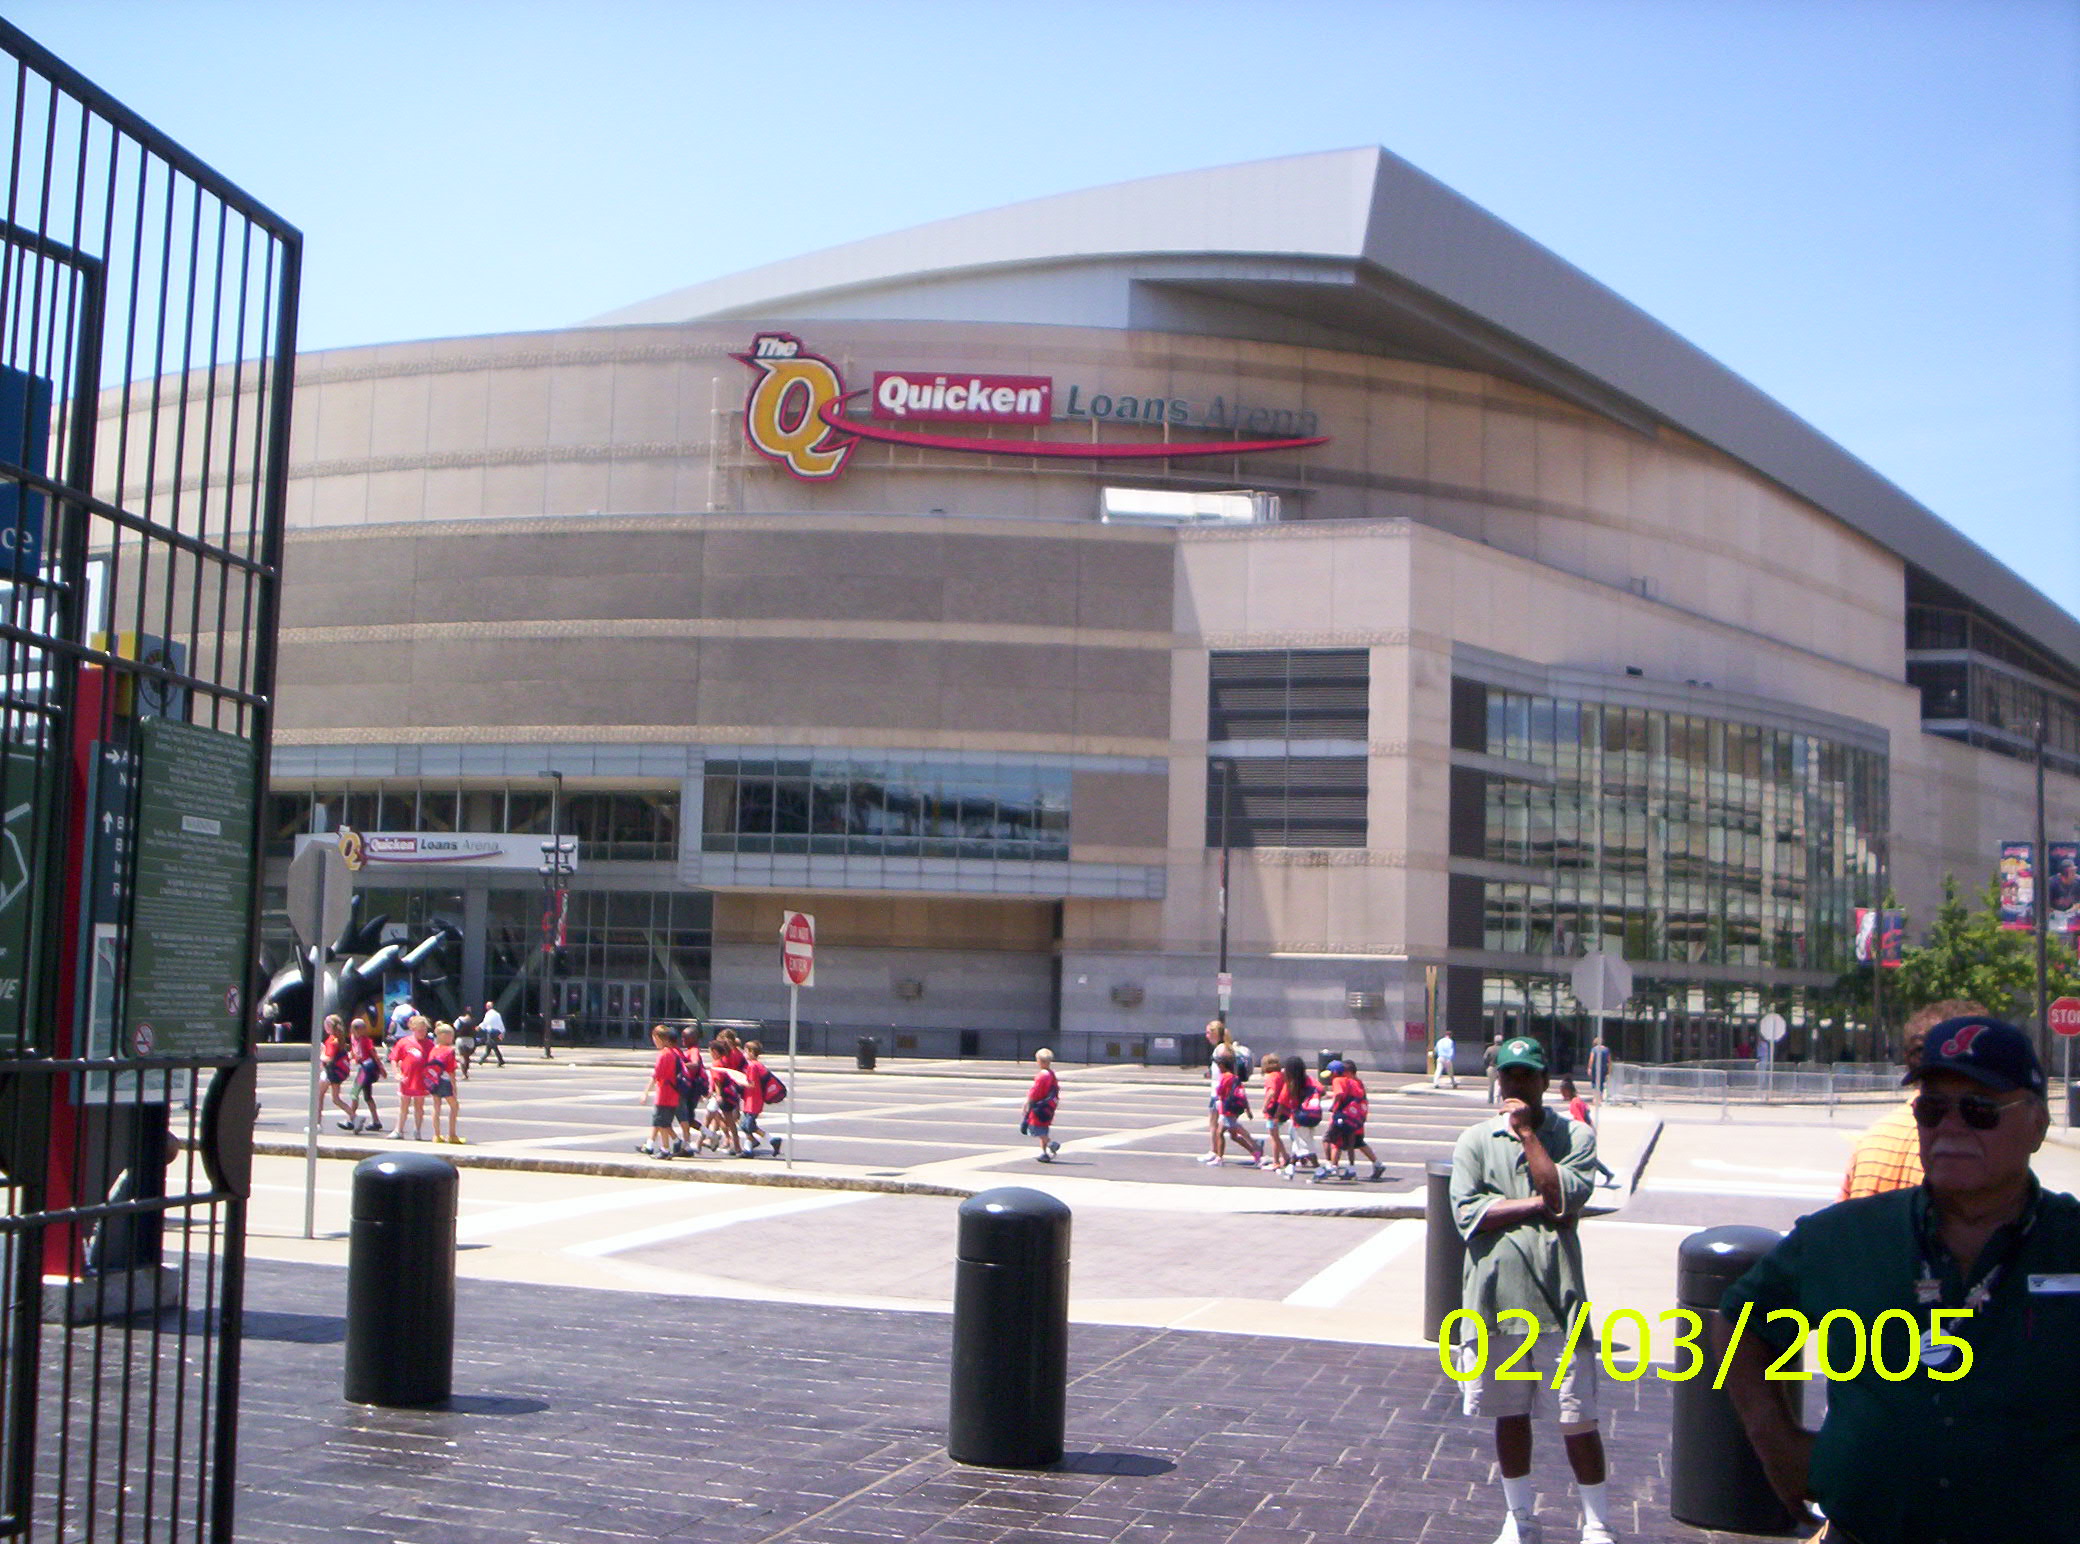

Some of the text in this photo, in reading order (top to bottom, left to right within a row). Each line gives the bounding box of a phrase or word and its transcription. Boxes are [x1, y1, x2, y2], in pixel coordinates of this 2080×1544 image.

[756, 336, 799, 357] The
[748, 357, 848, 476] Q
[878, 375, 1319, 438] Quicken Loans Arena
[371, 838, 500, 852] Quicken Loans Arena
